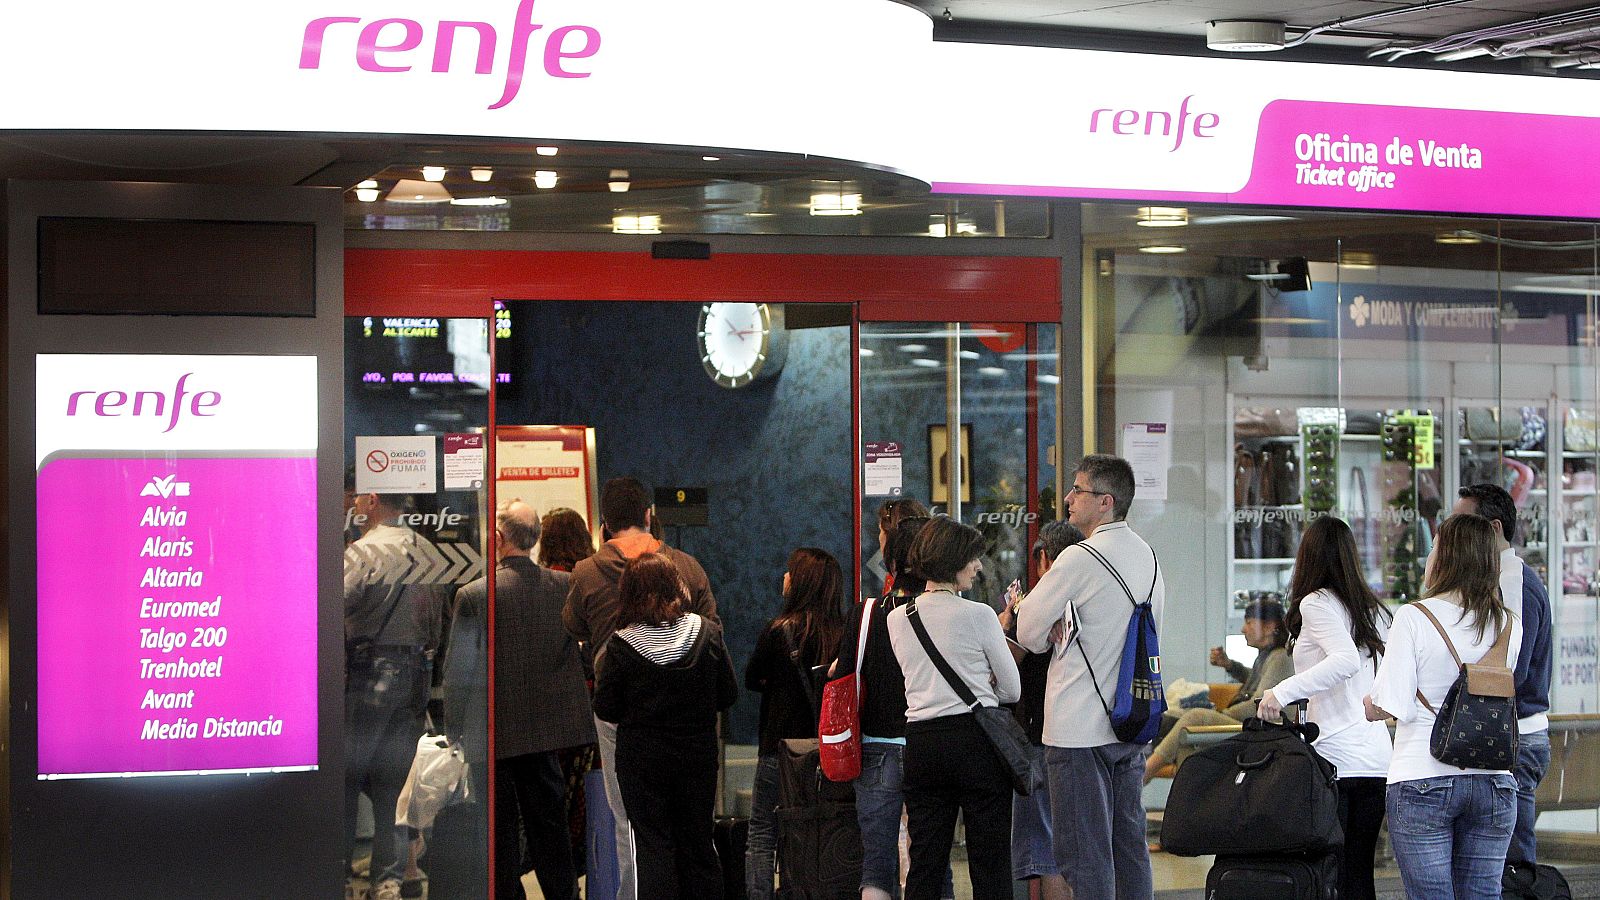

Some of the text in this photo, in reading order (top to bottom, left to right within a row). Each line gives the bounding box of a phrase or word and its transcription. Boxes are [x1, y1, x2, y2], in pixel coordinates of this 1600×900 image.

[299, 0, 602, 110] renfe
[1089, 95, 1220, 153] renfe
[1294, 132, 1482, 169] Oficina de Venta
[1295, 163, 1396, 192] Ticket office
[382, 318, 440, 328] VALENCIA
[1370, 300, 1402, 325] MODA
[1405, 301, 1413, 326] Y
[382, 327, 439, 337] ALICANTE
[392, 372, 415, 382] POR
[419, 372, 454, 383] FAVOR
[67, 373, 221, 433] renfe
[502, 466, 576, 477] VENTA DE BILLETES
[139, 474, 191, 499] AVE
[676, 489, 686, 502] 9
[139, 505, 188, 527] Alvia
[397, 506, 462, 532] renfe
[976, 505, 1038, 530] renfe
[139, 535, 194, 558] Alaris
[139, 566, 203, 588] Altaria
[139, 595, 222, 619] Euromed
[139, 626, 228, 653] Talgo 200
[139, 655, 223, 680] Trenhotel
[140, 688, 195, 710] Avant
[140, 714, 283, 741] Media Distancia
